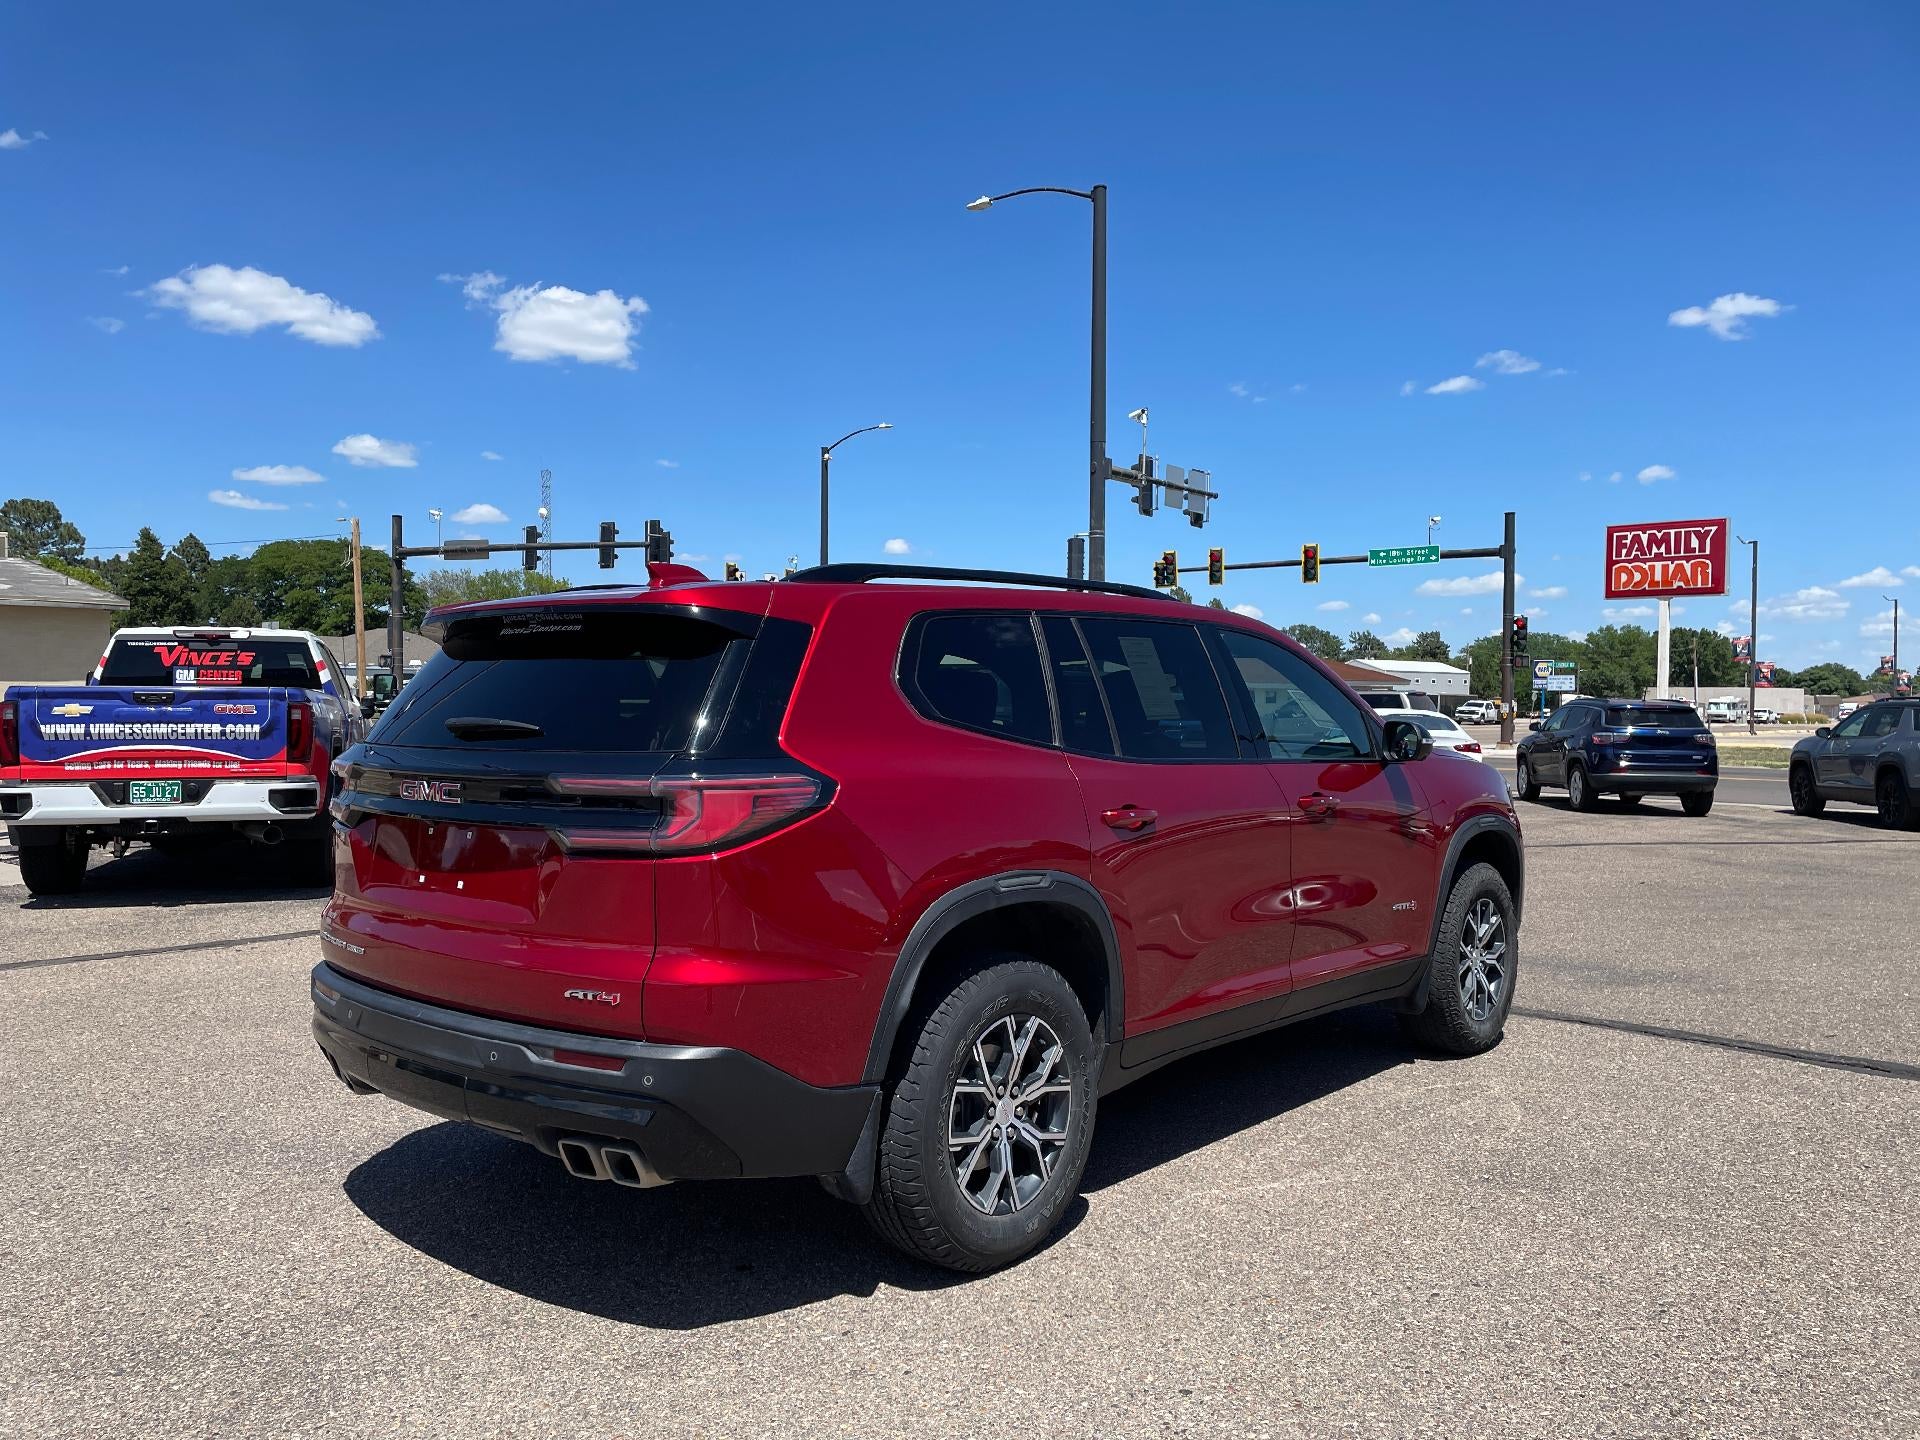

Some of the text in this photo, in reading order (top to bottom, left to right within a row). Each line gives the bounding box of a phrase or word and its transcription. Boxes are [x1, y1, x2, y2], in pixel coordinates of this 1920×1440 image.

[1613, 526, 1719, 560] FAMILY
[1612, 559, 1712, 591] DOLLAR
[175, 669, 242, 681] GM CENTER
[213, 704, 257, 715] GMC
[40, 723, 261, 741] WWW.VINCESGMCENTER.COM
[113, 760, 124, 769] for
[133, 786, 179, 798] 55 JU 27
[400, 779, 461, 804] GMC
[564, 990, 621, 1006] AT4
